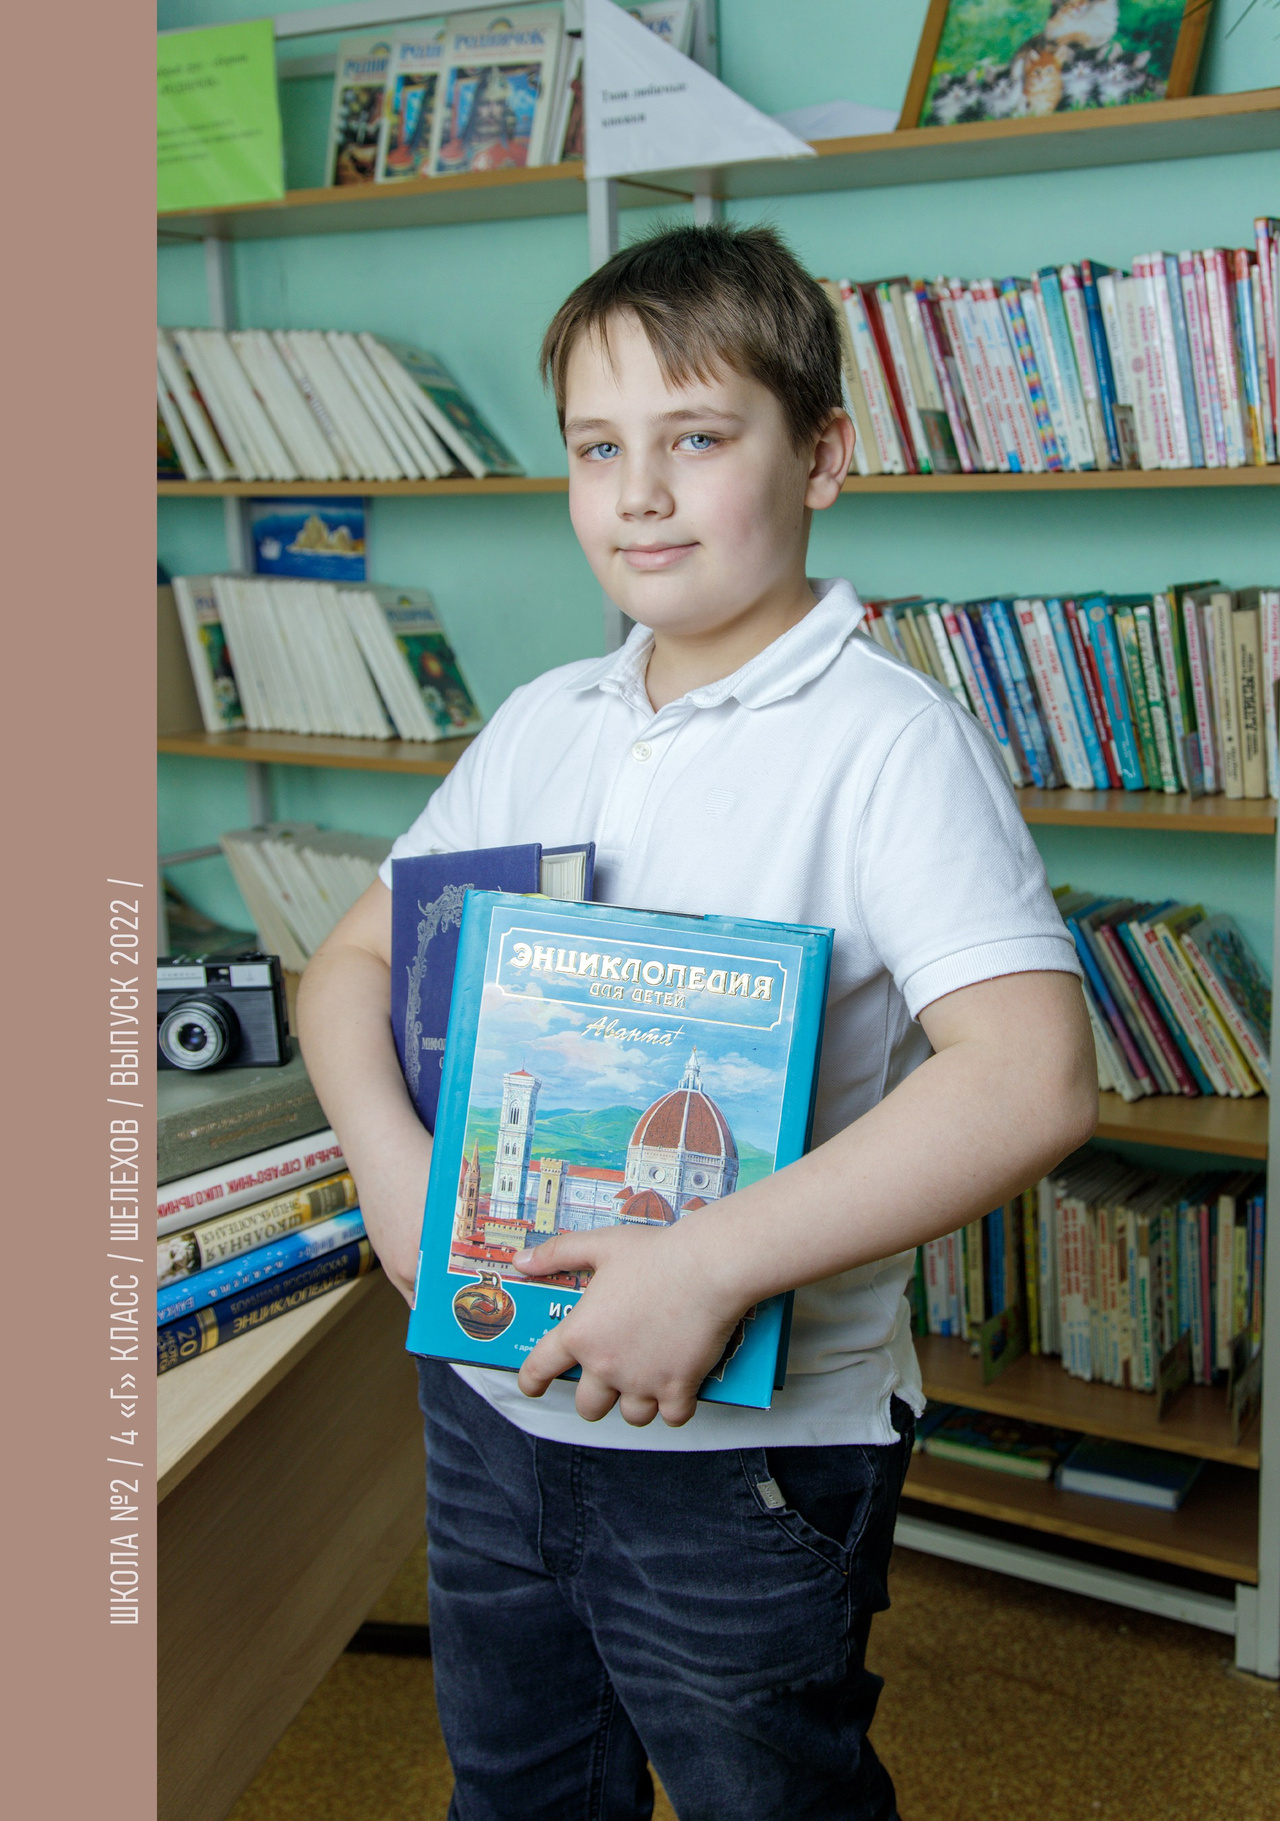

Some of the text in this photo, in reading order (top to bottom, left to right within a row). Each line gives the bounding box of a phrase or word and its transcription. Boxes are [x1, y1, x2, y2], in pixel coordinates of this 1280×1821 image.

[509, 942, 775, 1001] ЭНЦИКЛОПЕДИЯ
[589, 982, 687, 1009] ДЛЯ ДЕТЕЙ
[227, 1159, 302, 1195] СПРАВОЧНИК
[305, 1145, 343, 1172] ЛЬНЫЙ
[202, 1198, 302, 1246] ЭНЦИКЛОПЕДИЯ
[205, 1213, 303, 1262] ШКОЛЬНАЯ
[283, 1254, 349, 1293] РОССИЙСКАЯ
[156, 1296, 196, 1321] БАЙКА
[232, 1269, 348, 1335] ЭНЦИКЛОПЕДИЯ
[176, 1326, 198, 1356] 20
